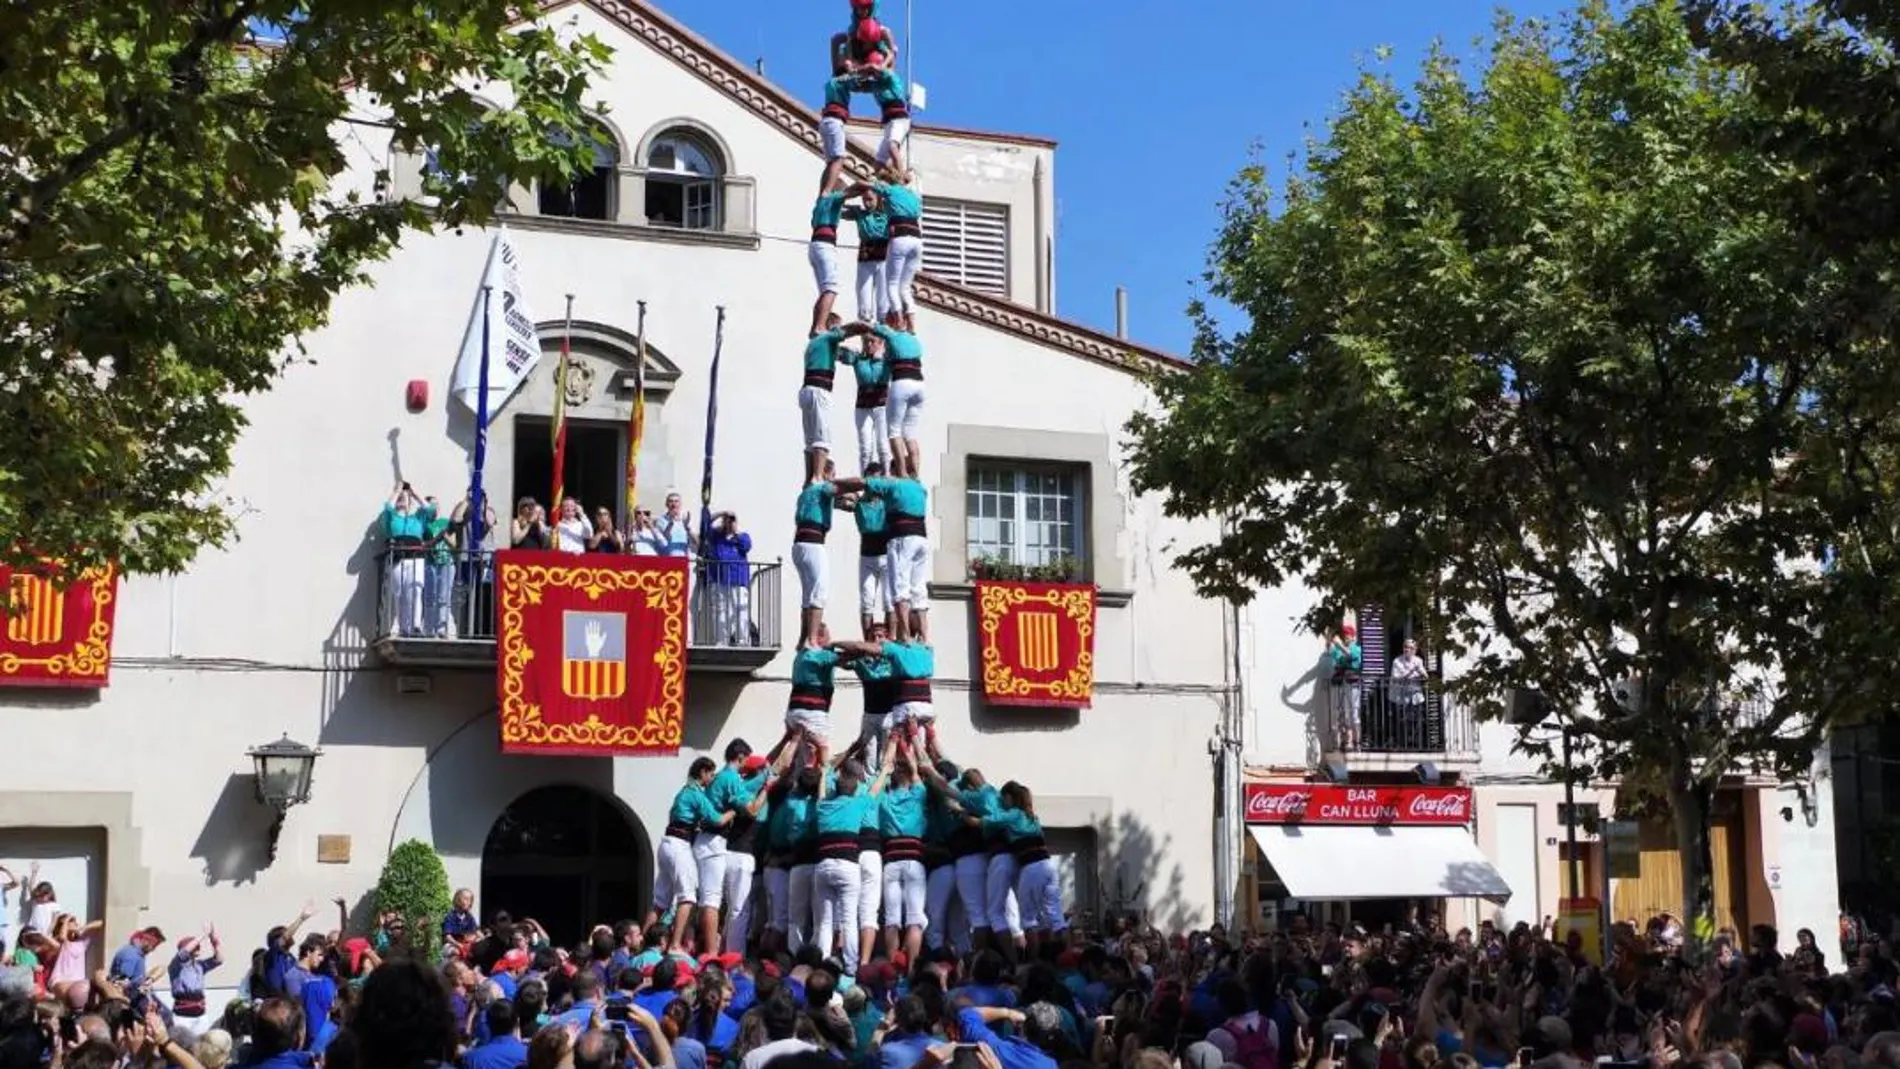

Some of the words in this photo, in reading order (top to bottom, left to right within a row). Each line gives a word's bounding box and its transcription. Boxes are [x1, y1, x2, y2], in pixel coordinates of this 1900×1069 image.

[1249, 791, 1312, 815] Coca-Cola
[1347, 789, 1377, 801] BAR
[1320, 805, 1350, 818] CAN
[1354, 805, 1399, 818] LLUNA
[1410, 793, 1469, 816] Coca-Cola
